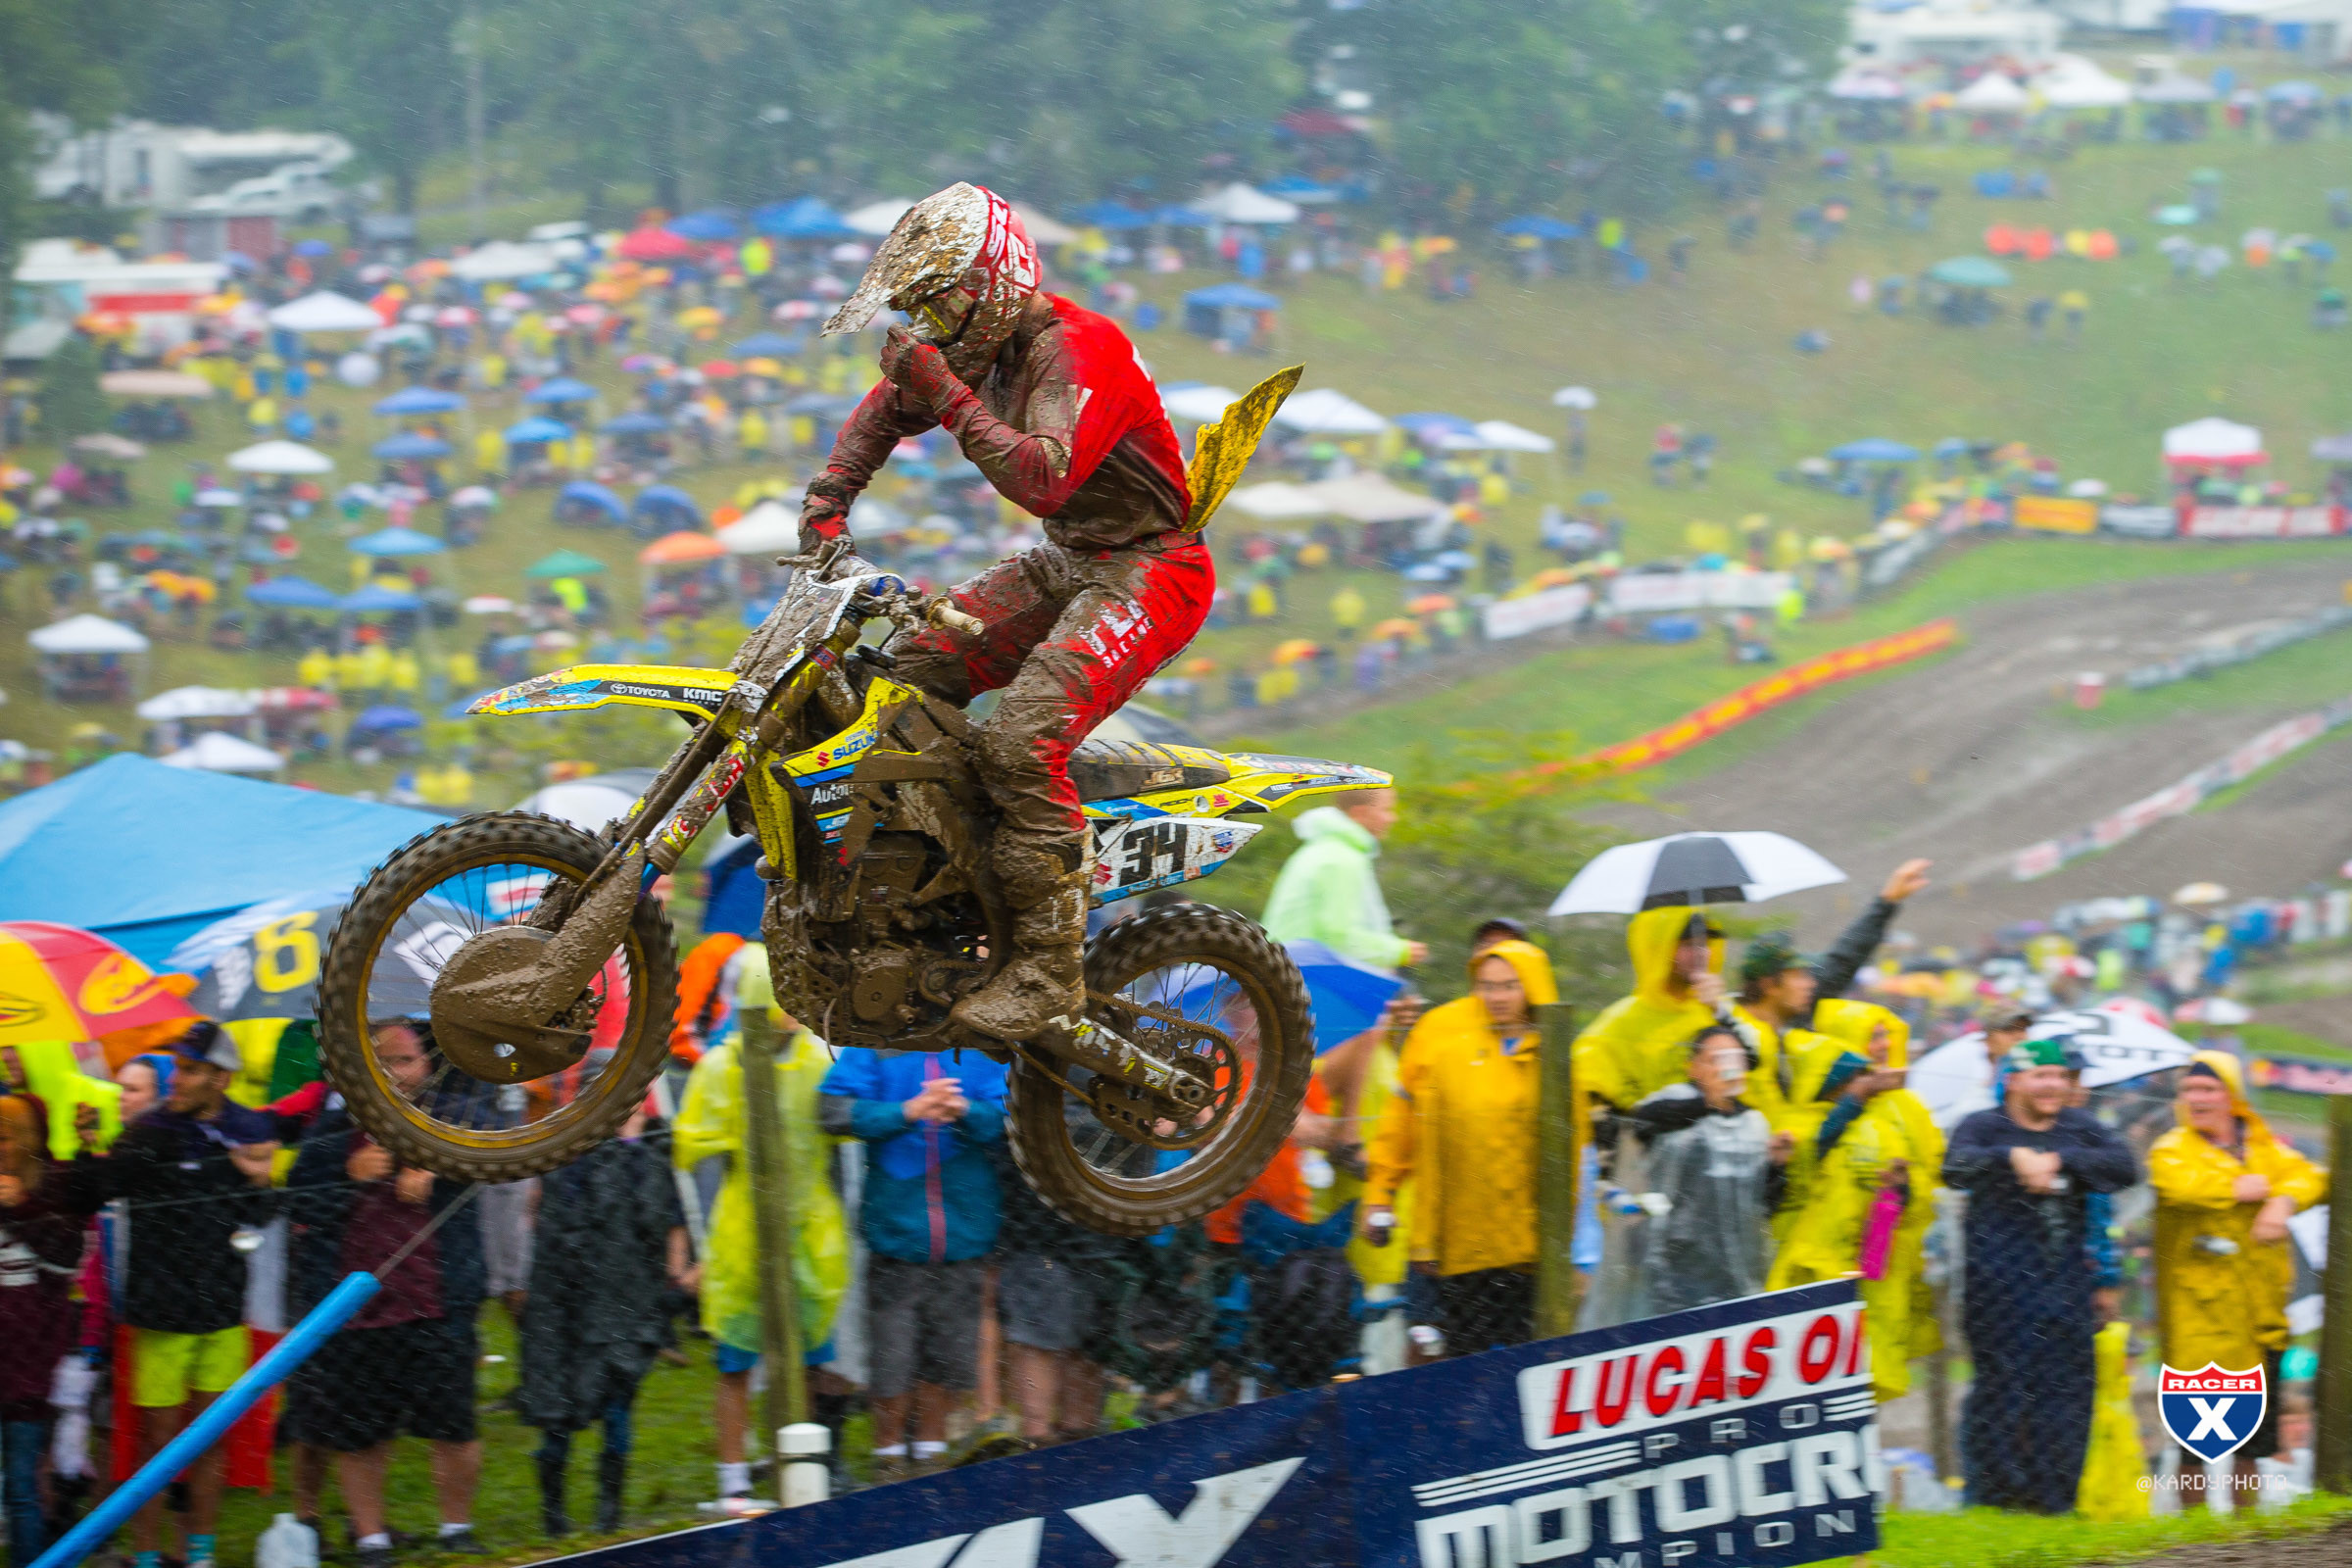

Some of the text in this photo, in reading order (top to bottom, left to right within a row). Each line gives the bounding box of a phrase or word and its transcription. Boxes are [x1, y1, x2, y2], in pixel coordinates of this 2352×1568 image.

[627, 686, 723, 702] TOYOTA KMC
[1119, 822, 1188, 887] 34
[1548, 1326, 1777, 1438] LUCAS
[1644, 1402, 1821, 1459] PRO
